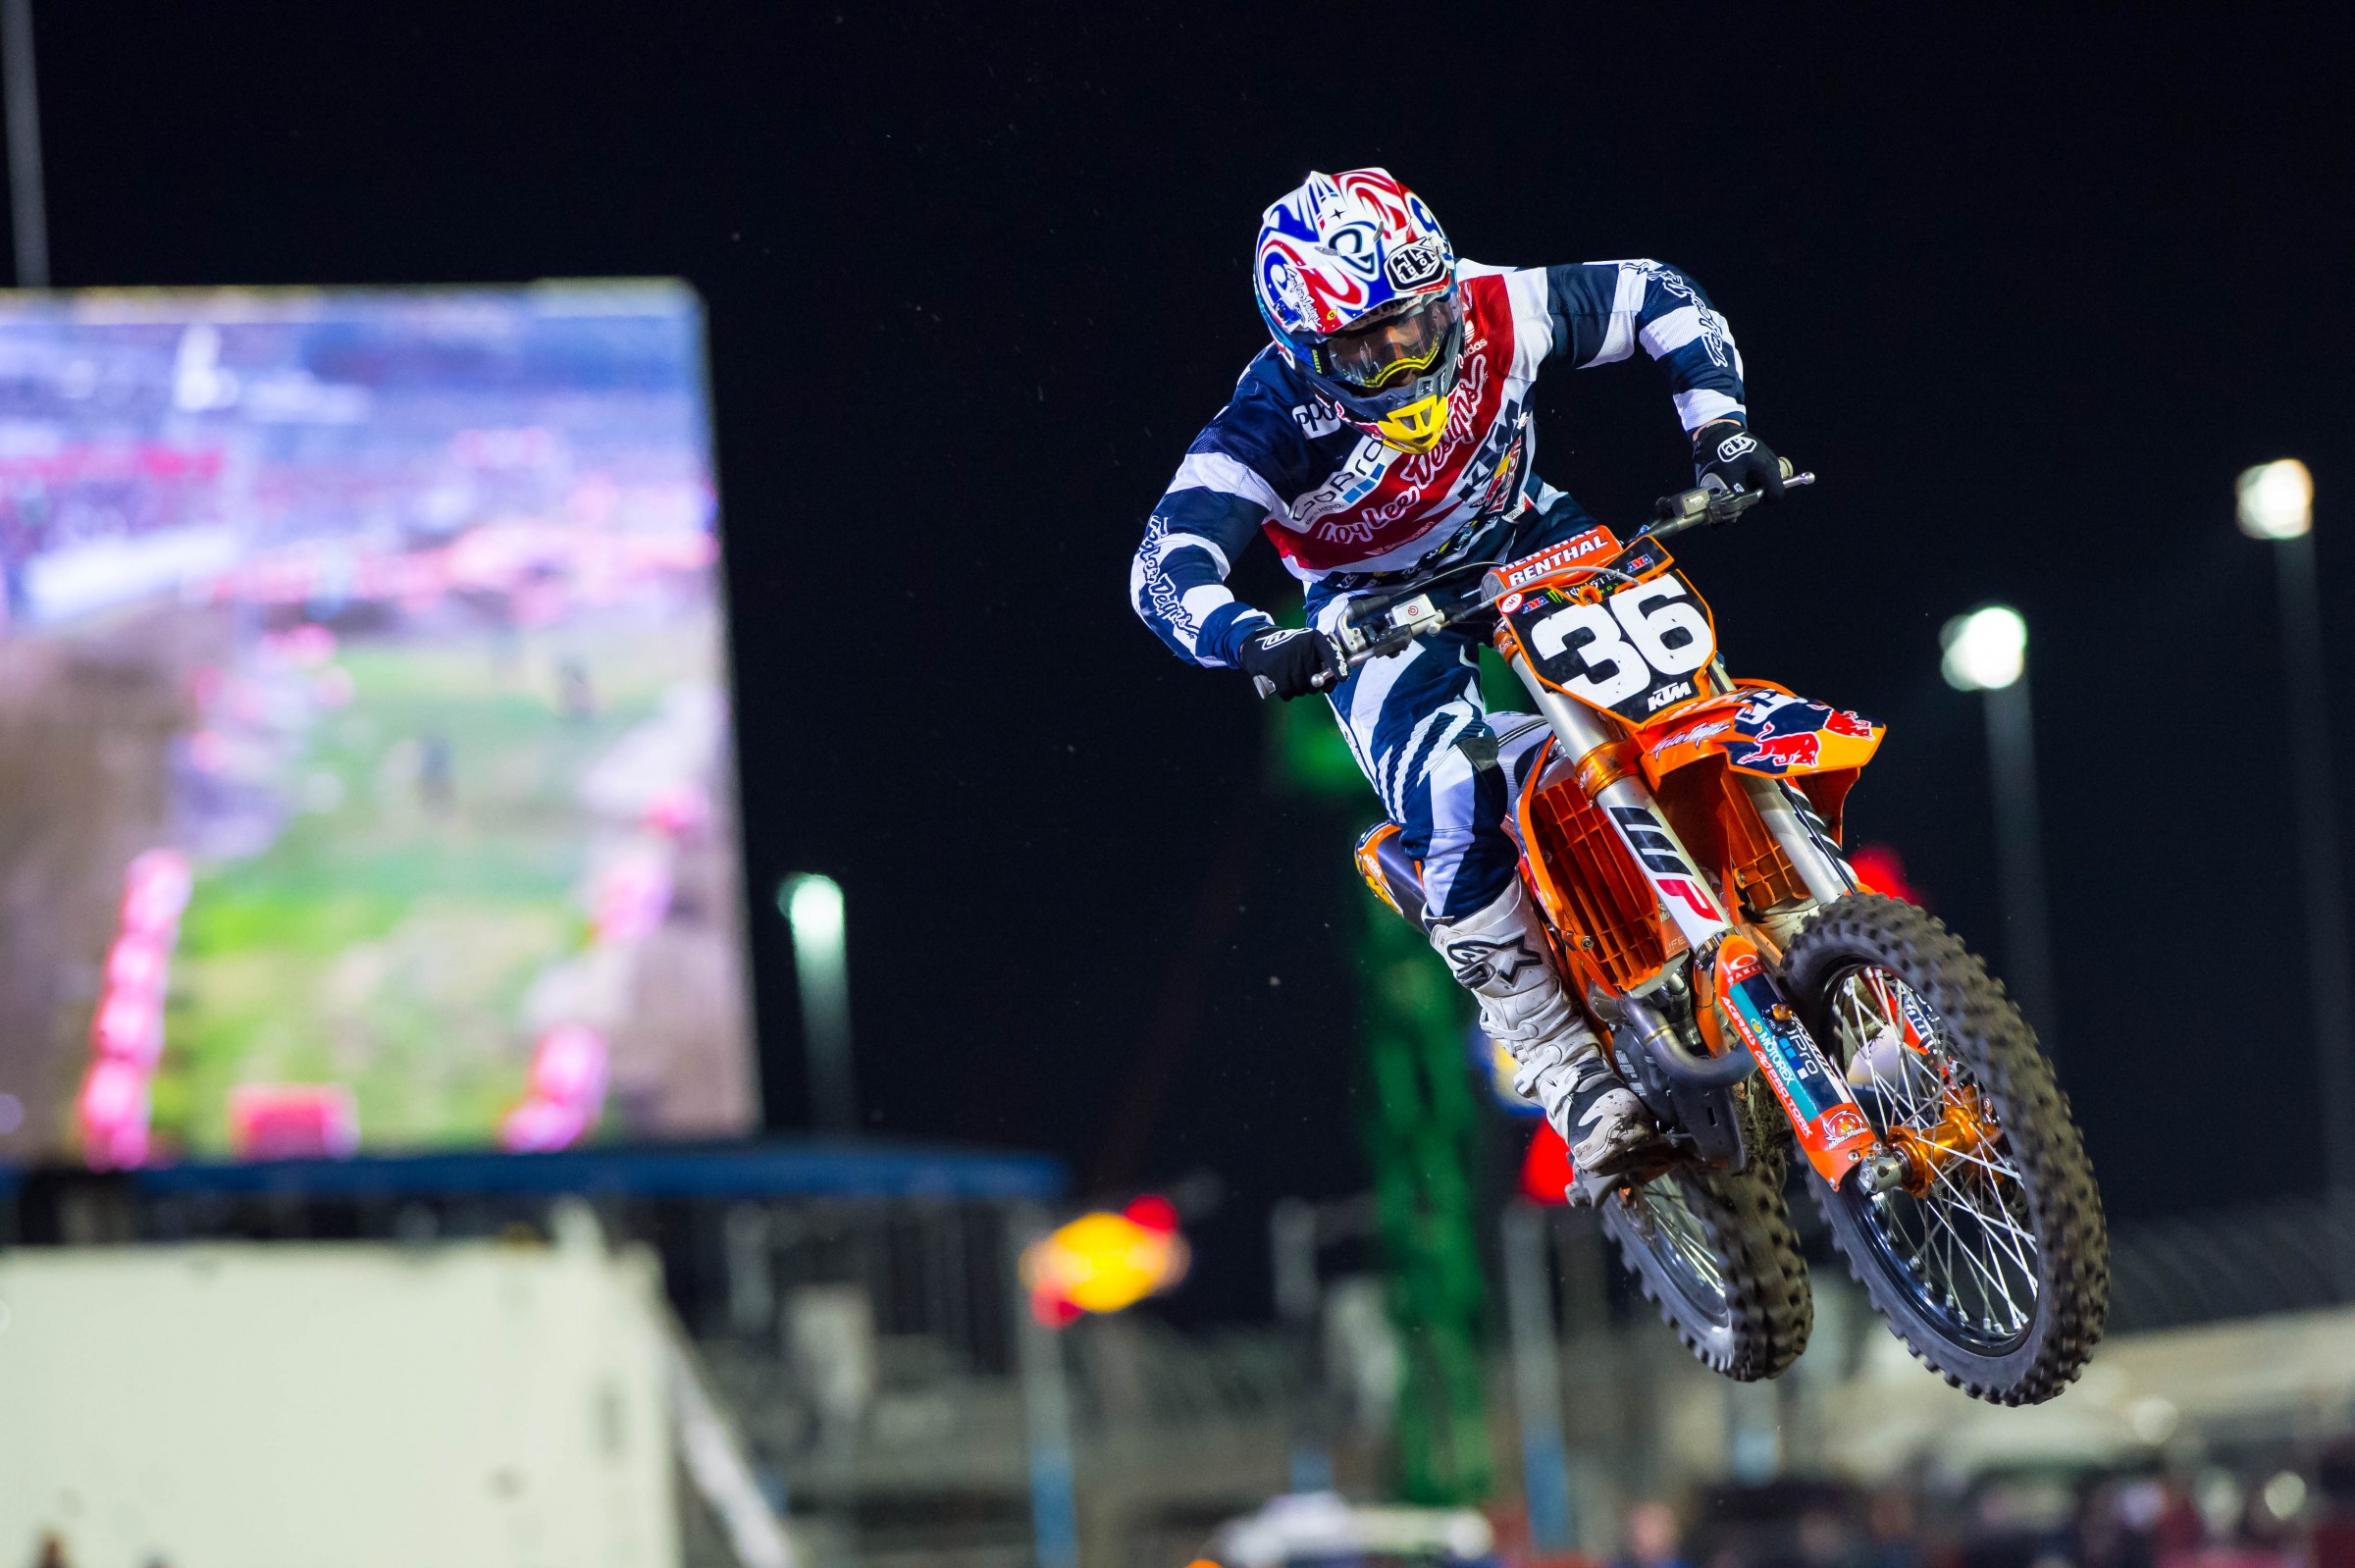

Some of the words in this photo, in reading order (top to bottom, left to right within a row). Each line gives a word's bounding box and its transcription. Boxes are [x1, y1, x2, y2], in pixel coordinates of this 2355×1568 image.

[1292, 439, 1384, 522] GoPro
[1508, 536, 1608, 587] RENTHAL
[1532, 573, 1714, 708] 36
[1648, 682, 1692, 711] KTM
[1721, 996, 1755, 1046] ACERBIS
[1758, 1031, 1795, 1086] MOTOREX
[1786, 1099, 1813, 1137] TORK
